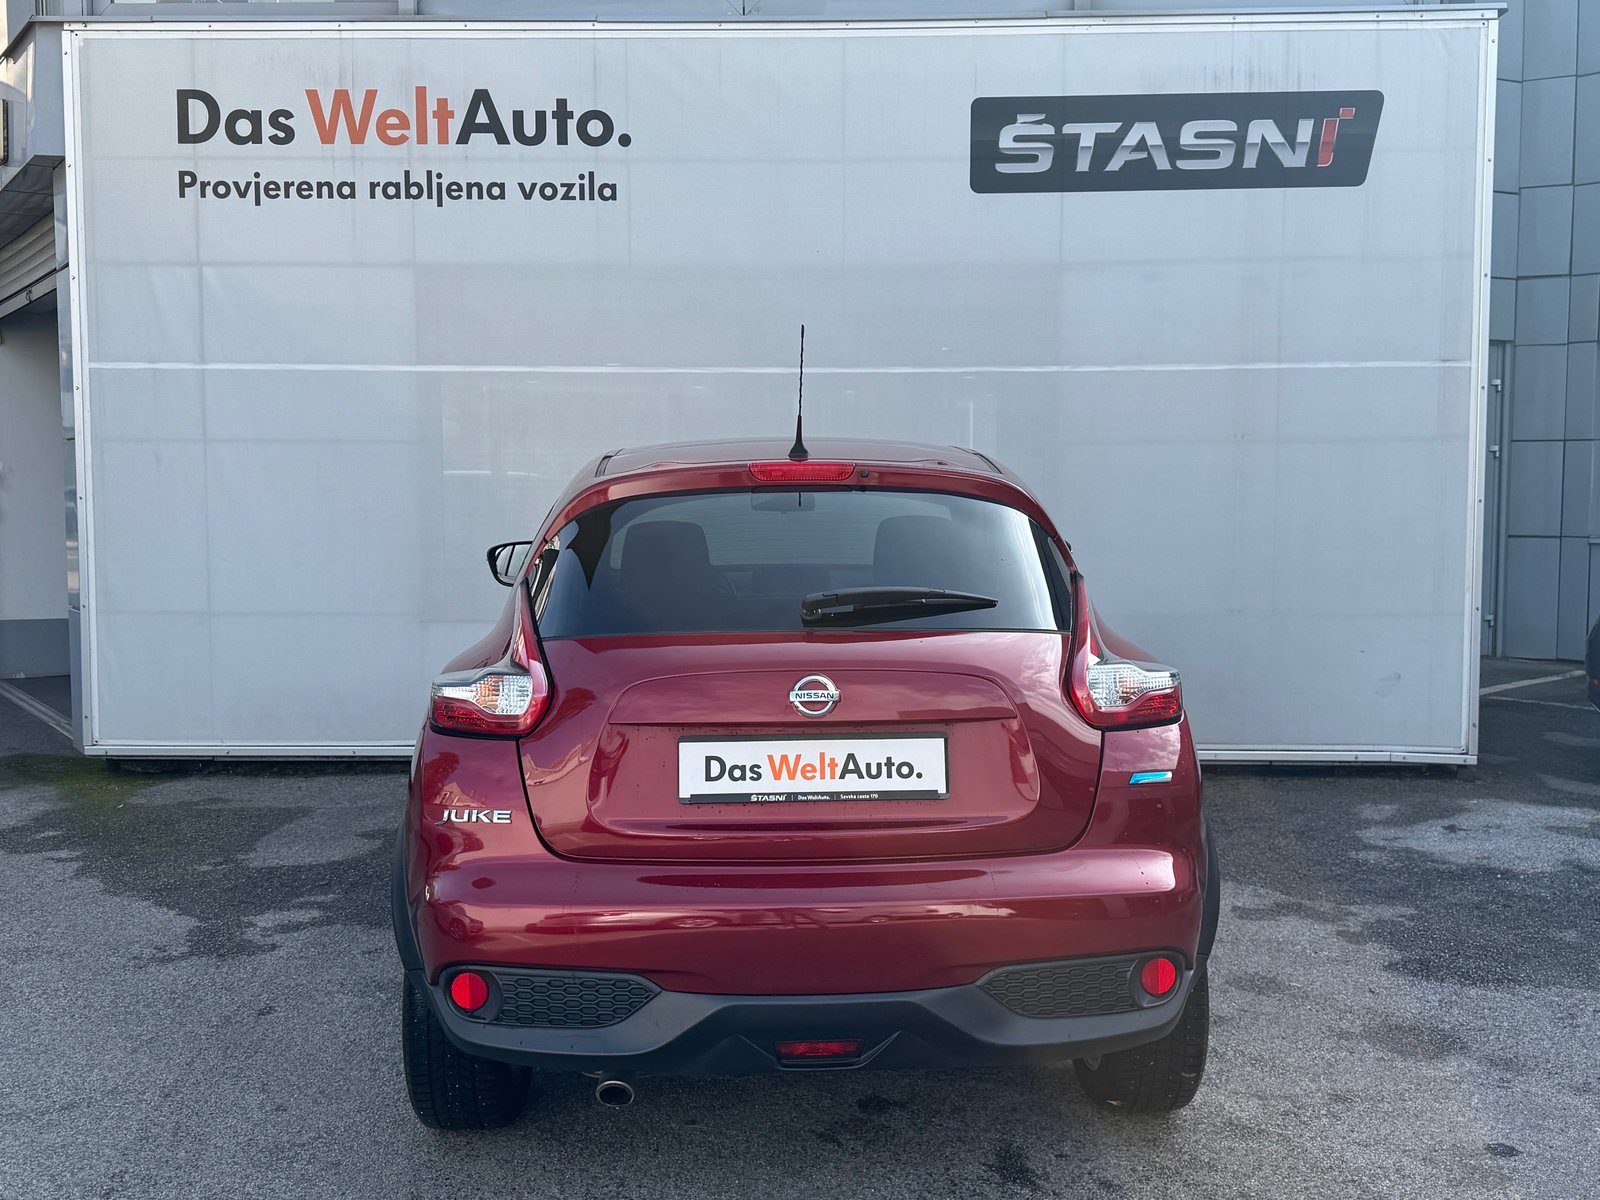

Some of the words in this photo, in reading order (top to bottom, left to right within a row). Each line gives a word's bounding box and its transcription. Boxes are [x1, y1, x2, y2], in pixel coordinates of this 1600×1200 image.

[176, 88, 296, 147] Das
[304, 85, 633, 148] WeltAuto.
[178, 170, 357, 206] Provjerena
[368, 169, 507, 207] rabljena
[517, 171, 618, 202] vozila
[795, 692, 835, 700] NISSAN
[705, 754, 763, 782] Das
[767, 752, 923, 780] WeltAuto.
[435, 809, 513, 825] JUKE
